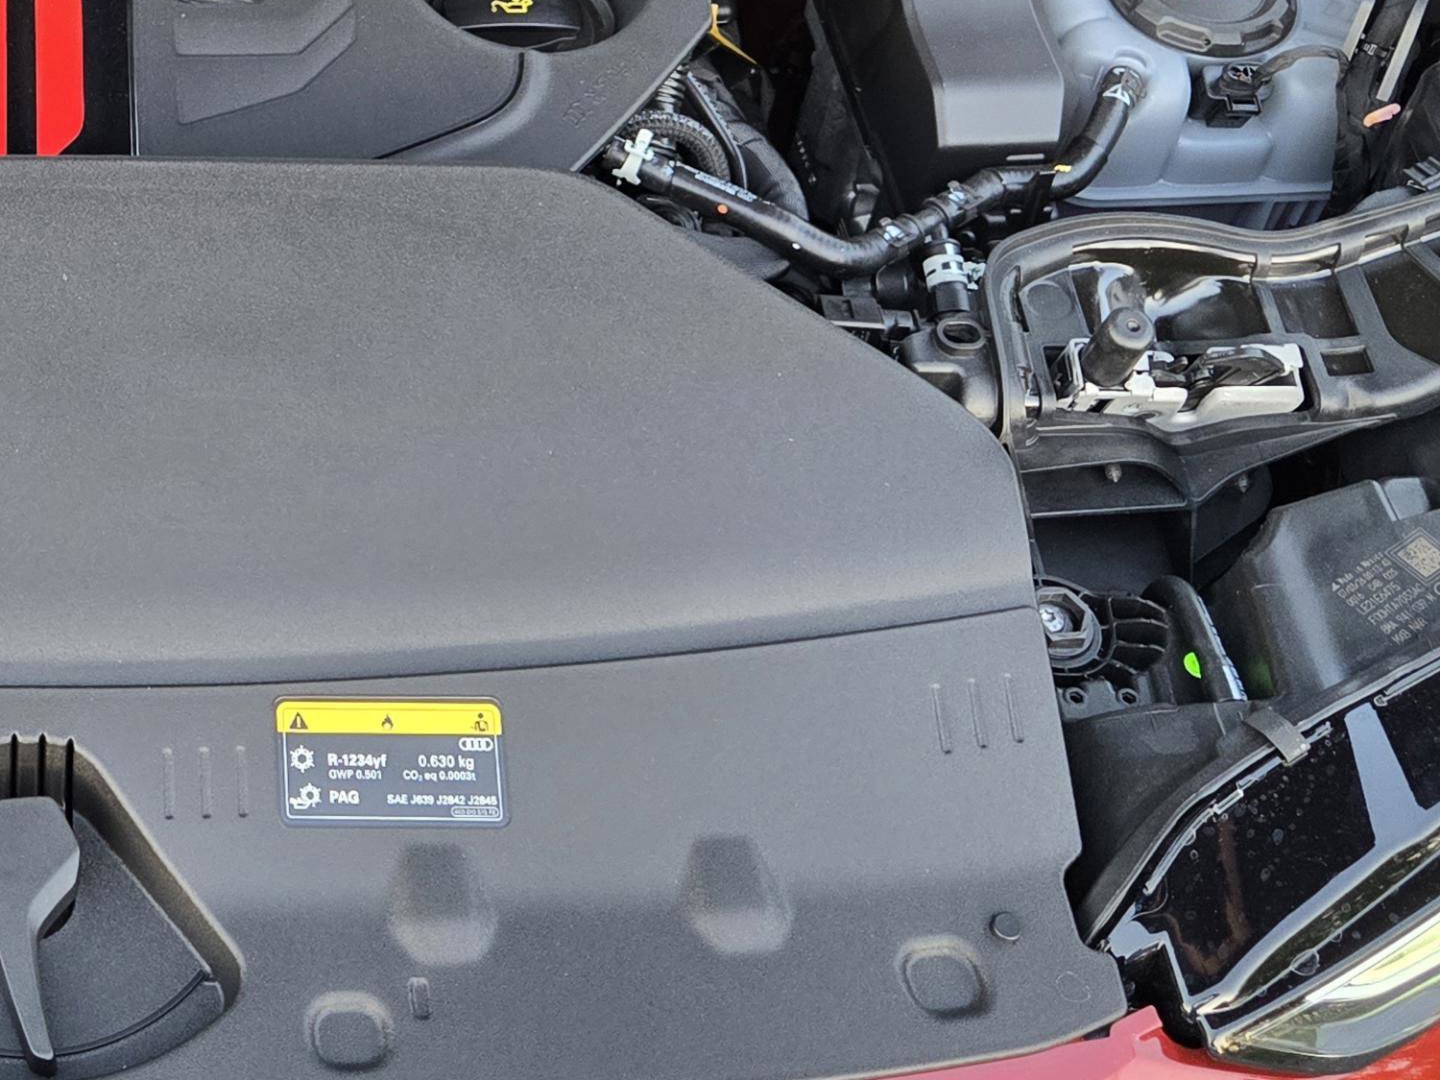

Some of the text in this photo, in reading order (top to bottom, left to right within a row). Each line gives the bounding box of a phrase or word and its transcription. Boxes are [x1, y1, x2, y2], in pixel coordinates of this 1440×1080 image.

[327, 753, 475, 770] R-1234yf 0.630 kg
[328, 770, 354, 780] GWP
[356, 770, 382, 780] 0.501
[424, 772, 438, 782] eq
[329, 790, 360, 804] PAG
[387, 794, 408, 804] SAE
[410, 794, 434, 805] J639
